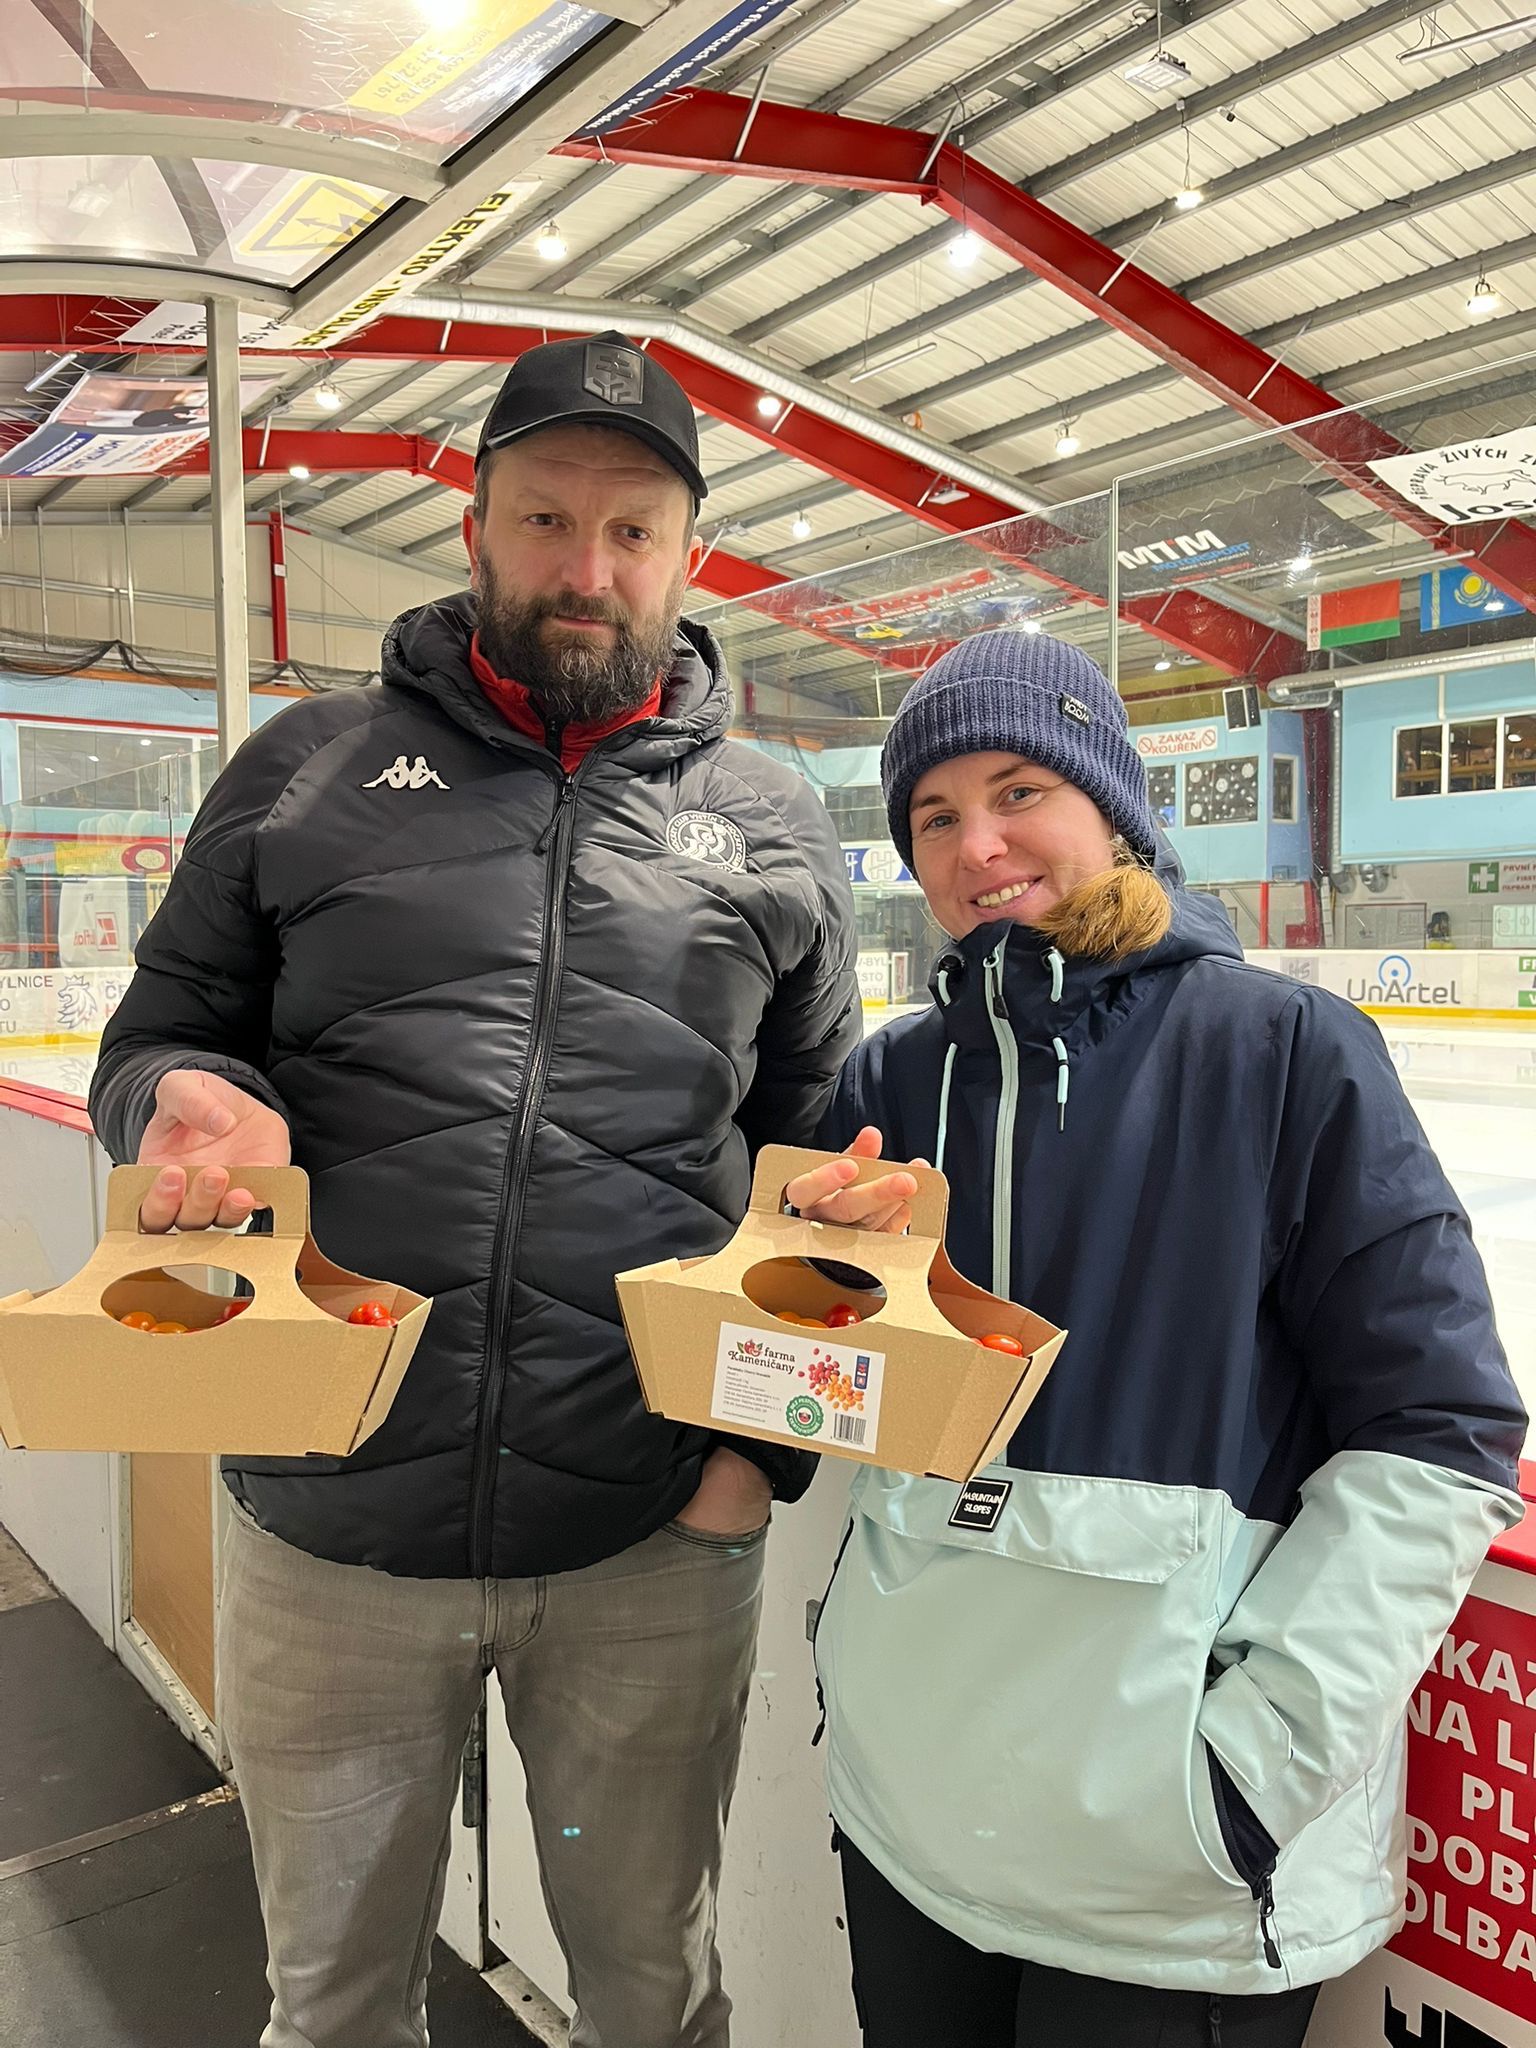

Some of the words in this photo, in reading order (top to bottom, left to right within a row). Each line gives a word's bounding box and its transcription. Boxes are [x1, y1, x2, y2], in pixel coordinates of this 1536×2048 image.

[691, 13, 762, 62] finančních
[400, 192, 512, 276] ELEKTRO
[291, 286, 401, 347] INSTALACE
[1409, 462, 1439, 500] PŘEPRAVA
[1439, 444, 1508, 464] ŽIVÝCH
[1439, 499, 1536, 522] Jos
[1503, 863, 1530, 872] PRVNÍ
[1346, 978, 1461, 1004] UnArtel
[728, 1350, 795, 1375] Kameničany
[764, 1346, 796, 1362] farma
[962, 1492, 1003, 1504] MOUNTAIN
[963, 1502, 993, 1515] SLOPES
[1427, 1632, 1536, 1710] KA
[1461, 1771, 1536, 1844] PL
[1405, 1813, 1536, 1914] DOB
